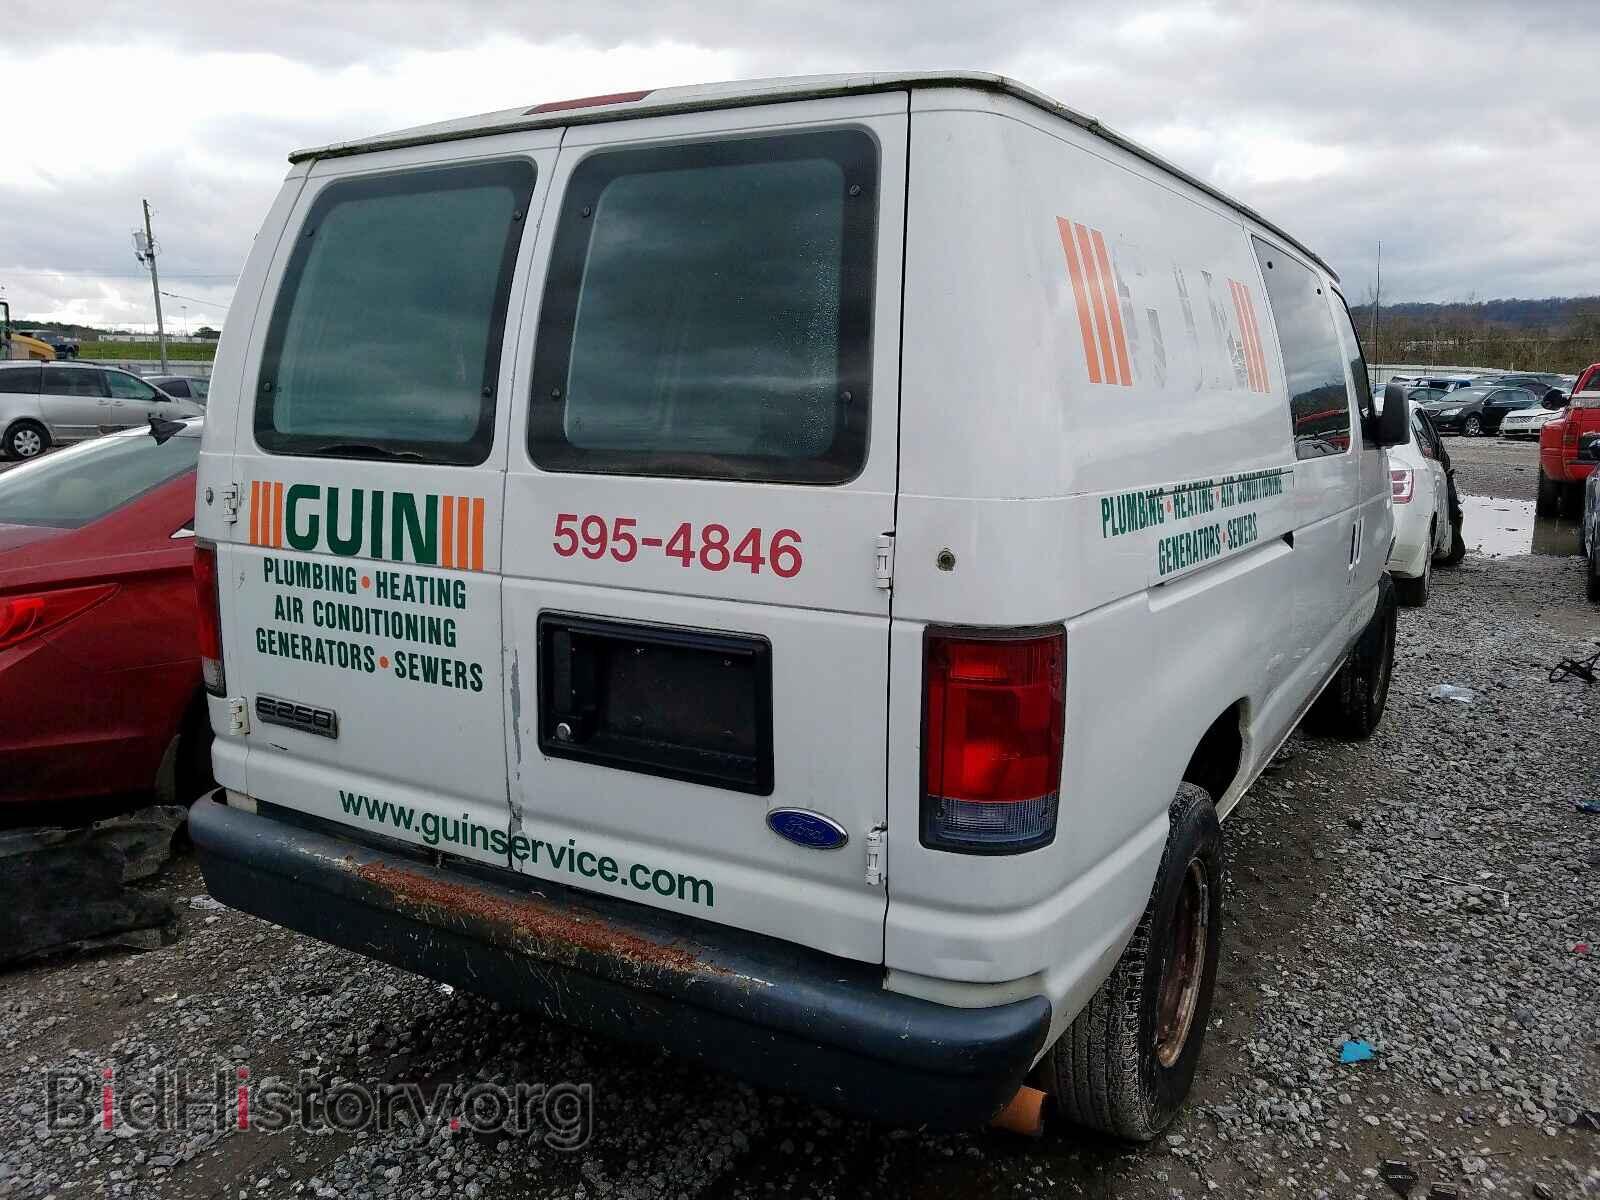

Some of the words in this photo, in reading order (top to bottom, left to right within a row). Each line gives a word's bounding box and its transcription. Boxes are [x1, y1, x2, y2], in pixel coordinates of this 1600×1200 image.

[285, 483, 439, 565] GUIN
[1100, 488, 1165, 539] PLUMBING
[1173, 479, 1214, 521] HEATING
[1221, 475, 1235, 509] AIR
[1237, 468, 1283, 505] CONDITIONING
[552, 512, 803, 578] 595-4846
[1158, 523, 1221, 576] GENERATORS
[1227, 511, 1258, 550] SEWERS
[263, 556, 357, 595] PLUMBING
[375, 570, 466, 610] HEATING
[274, 595, 304, 624] AIR
[313, 600, 456, 648] CONDITIONING
[256, 627, 376, 673] GENERATORS
[394, 651, 483, 692] SEWERS
[338, 789, 714, 907] www.guinservice.com
